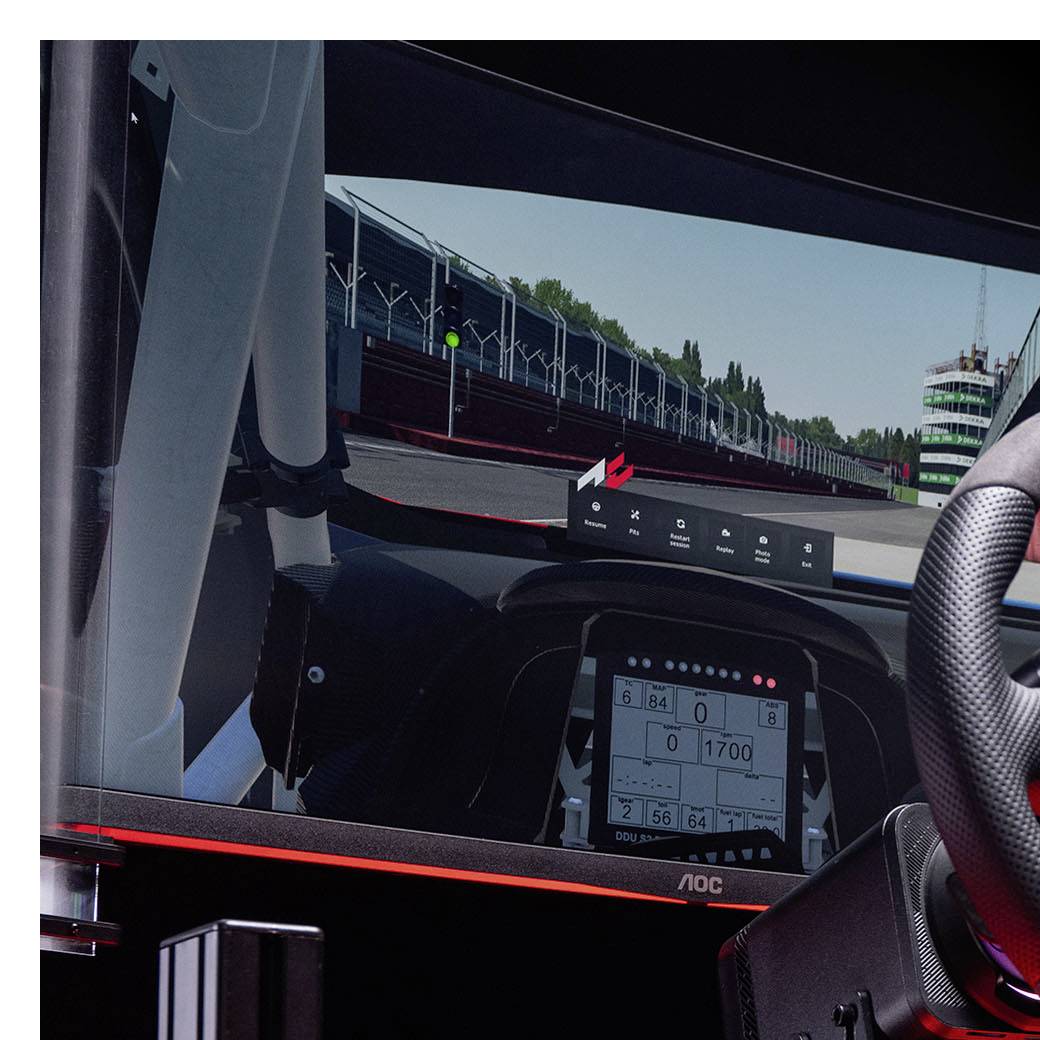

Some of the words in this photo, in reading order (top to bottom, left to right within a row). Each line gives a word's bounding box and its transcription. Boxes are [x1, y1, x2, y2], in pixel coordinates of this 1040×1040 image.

[583, 519, 607, 529] Resume
[629, 528, 640, 536] Pits
[669, 533, 690, 542] Restart
[669, 540, 690, 549] session
[716, 545, 735, 555] Replay
[755, 549, 771, 558] Photo
[622, 690, 631, 705] 6
[649, 694, 667, 710] 84
[694, 702, 707, 724] 0
[768, 711, 776, 725] 8
[667, 734, 678, 752] 0
[705, 739, 752, 762] 1700
[622, 804, 631, 819] 2
[653, 810, 671, 826] 56
[688, 814, 706, 830] 64
[615, 831, 637, 842] DDU
[677, 873, 723, 894] AOC
